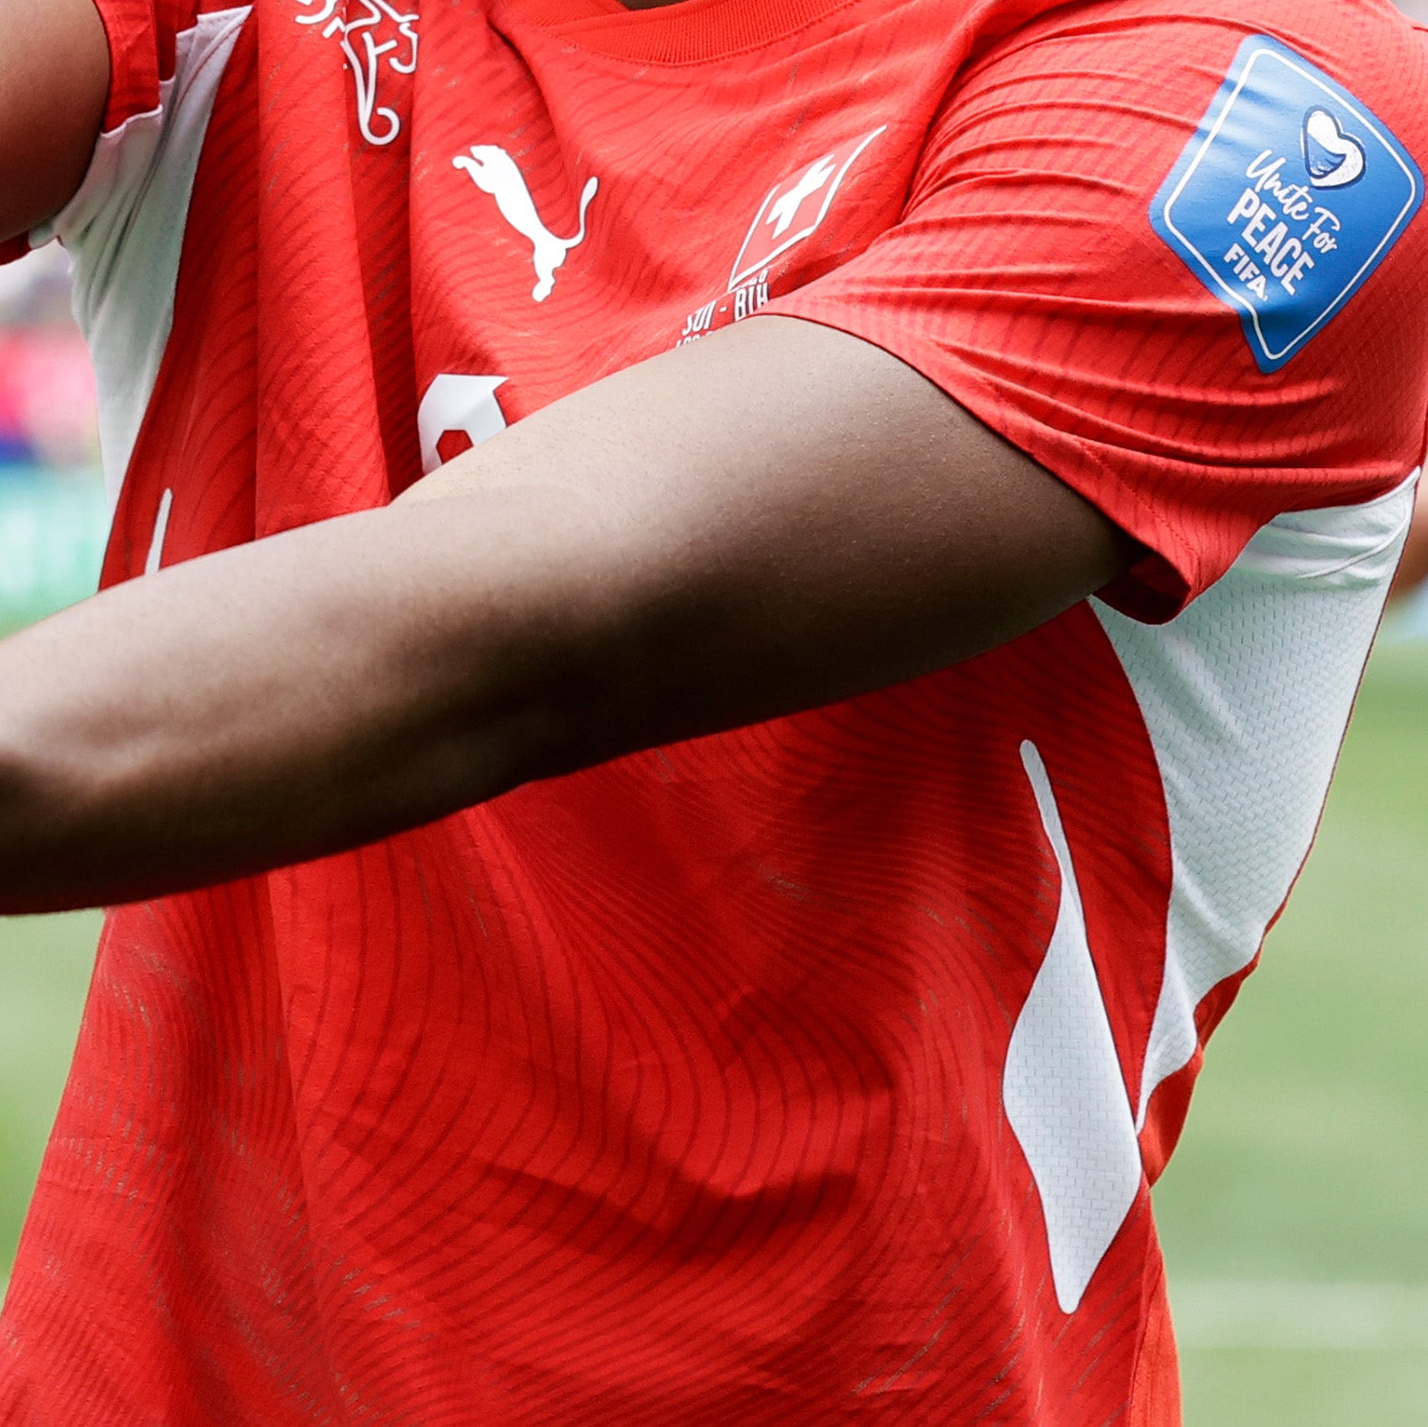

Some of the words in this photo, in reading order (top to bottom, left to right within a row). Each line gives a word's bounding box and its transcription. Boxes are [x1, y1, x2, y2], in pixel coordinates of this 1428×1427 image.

[1226, 187, 1315, 296] PEACE
[1246, 149, 1313, 221] Unite
[1302, 206, 1341, 253] For
[1223, 243, 1268, 301] FIFA
